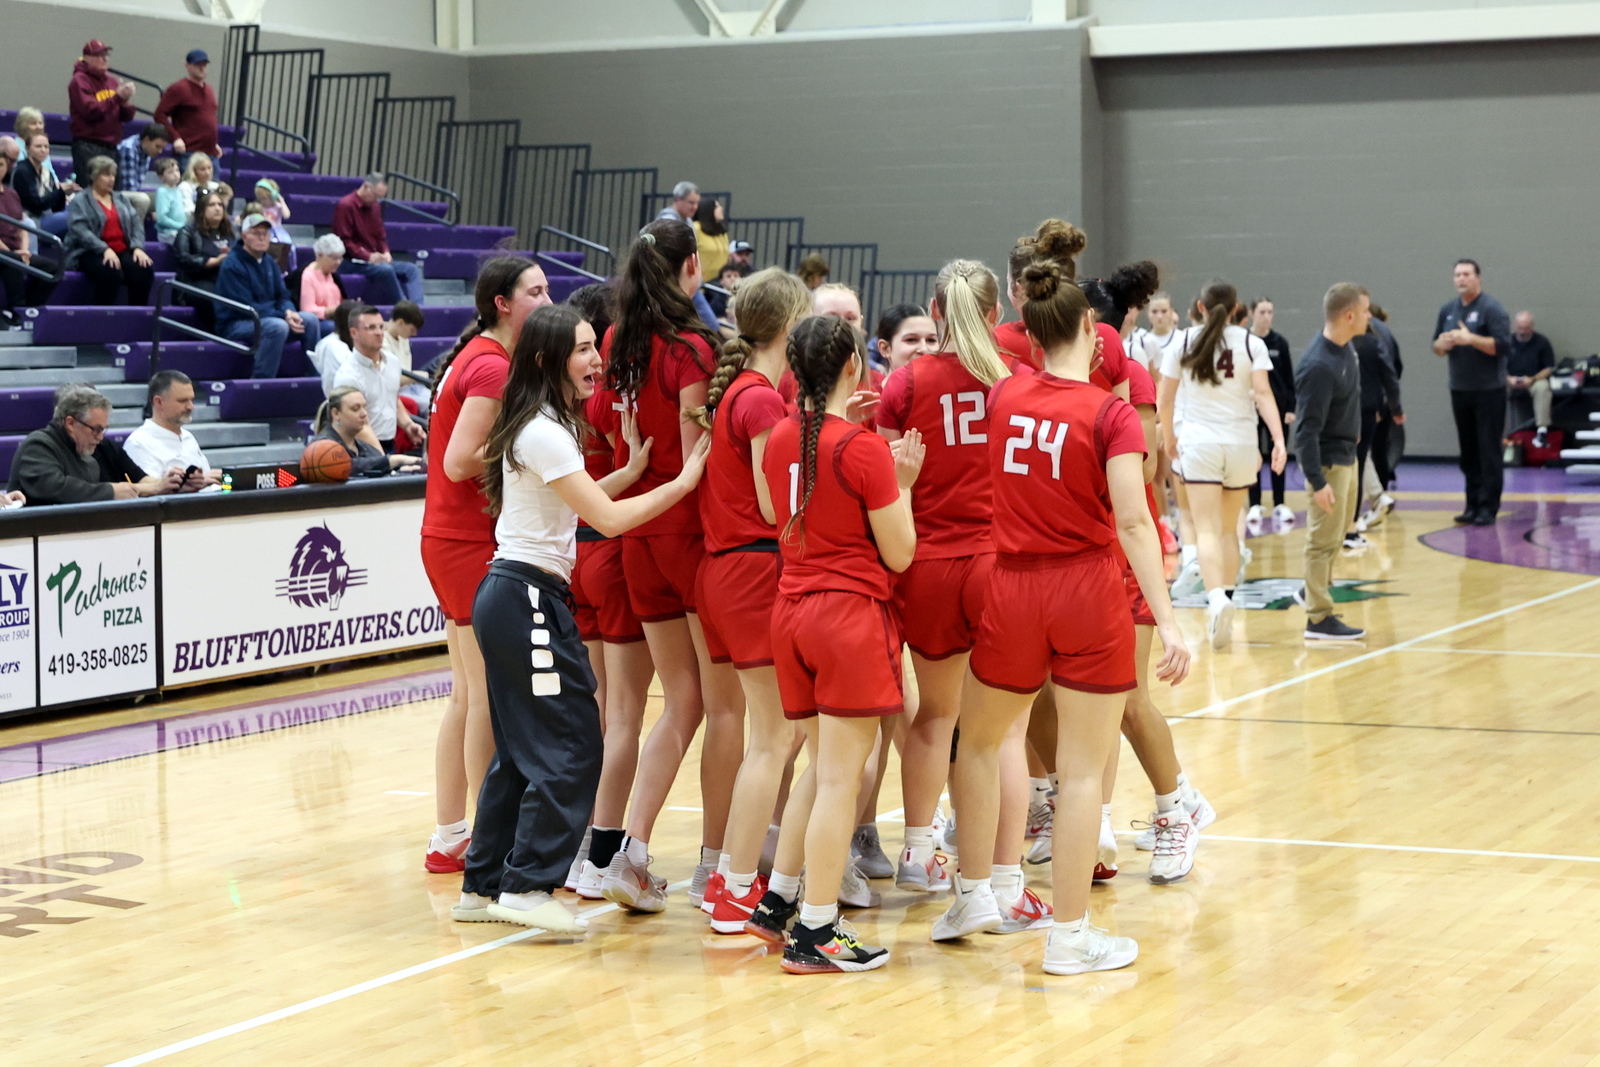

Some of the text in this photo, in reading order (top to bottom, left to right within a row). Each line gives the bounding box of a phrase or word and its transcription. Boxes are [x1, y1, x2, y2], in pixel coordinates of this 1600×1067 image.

[939, 391, 988, 446] 12
[1003, 414, 1069, 480] 24
[256, 472, 277, 489] POSS.
[46, 557, 148, 638] Padrone's
[103, 606, 143, 628] PIZZA
[12, 629, 30, 640] 1904
[48, 642, 148, 676] 419-358-0825
